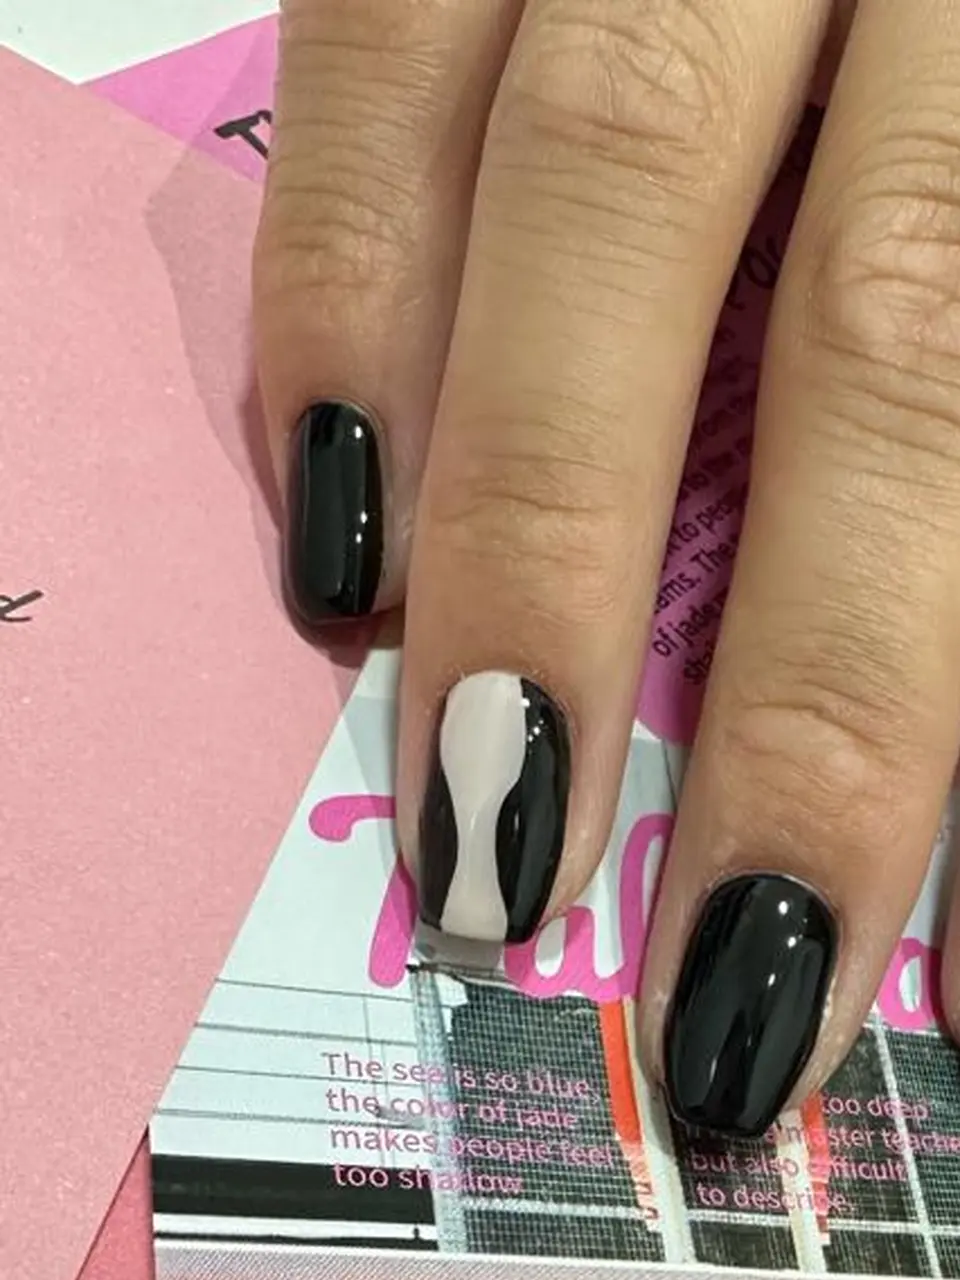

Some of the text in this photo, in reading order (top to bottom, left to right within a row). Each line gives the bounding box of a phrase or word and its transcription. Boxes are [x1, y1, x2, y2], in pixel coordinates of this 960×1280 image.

[322, 1051, 382, 1079] The
[393, 1062, 446, 1083] sea
[456, 1063, 477, 1088] is
[487, 1071, 518, 1092] so
[326, 1089, 380, 1115] the
[479, 1099, 508, 1124] of
[516, 1100, 580, 1131] jade
[329, 1127, 438, 1152] makes
[450, 1134, 552, 1164] people
[334, 1162, 389, 1187] too
[690, 1150, 738, 1173] but
[745, 1153, 800, 1177] also
[696, 1181, 727, 1206] to
